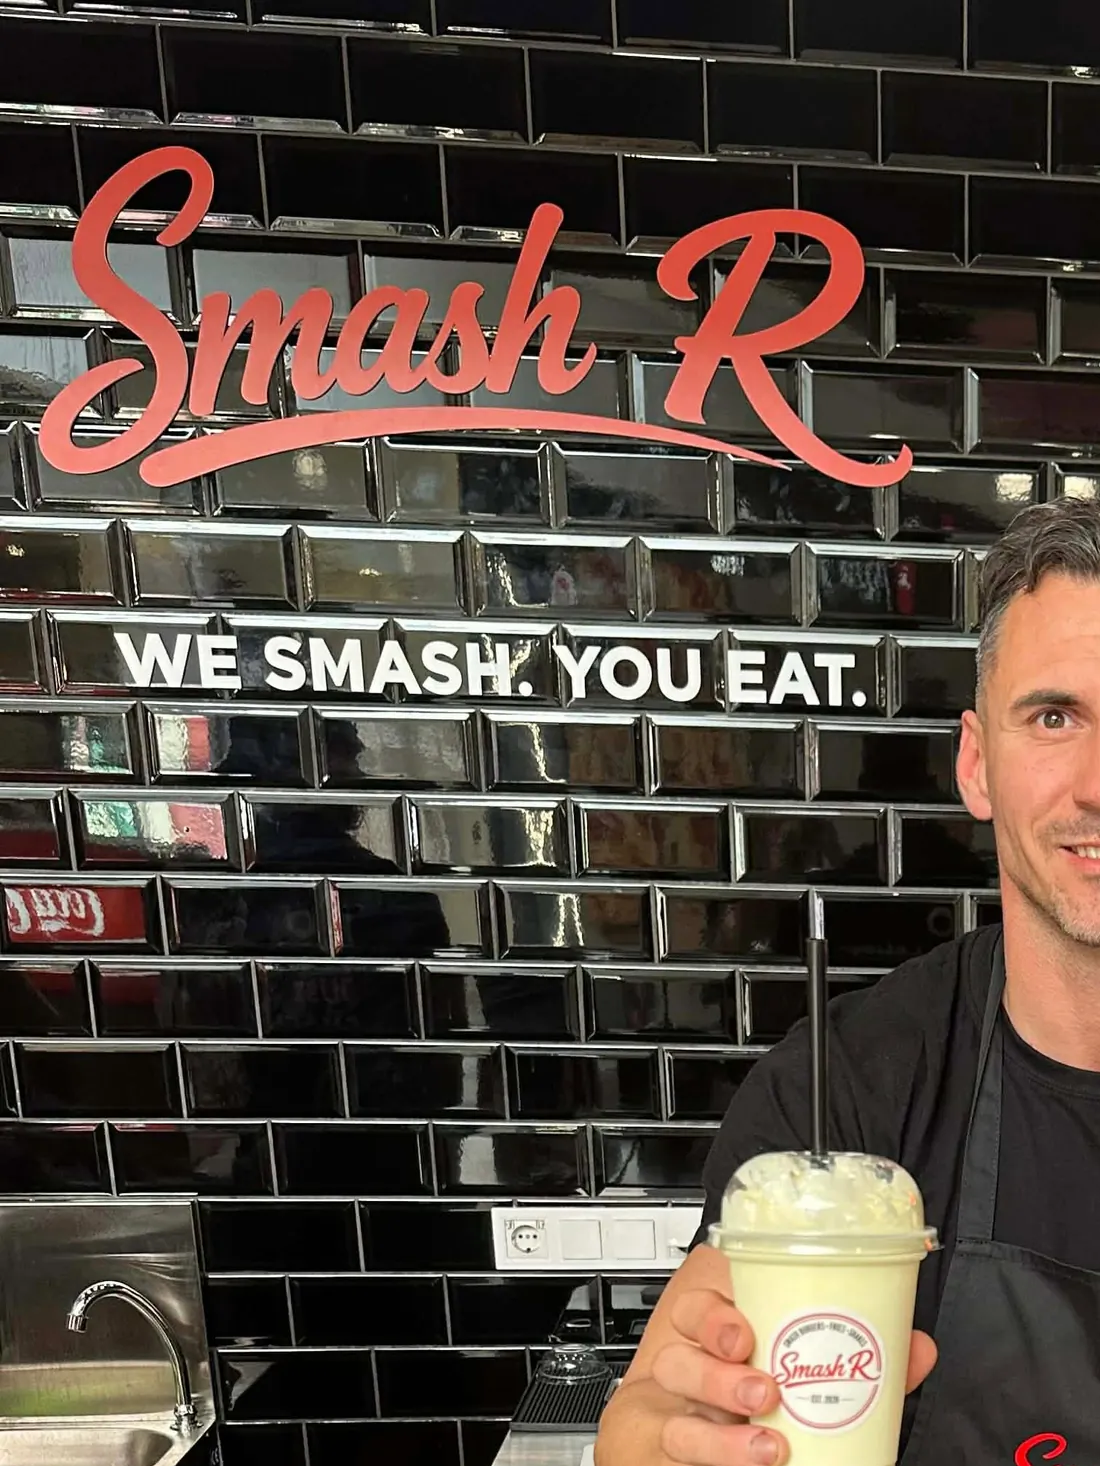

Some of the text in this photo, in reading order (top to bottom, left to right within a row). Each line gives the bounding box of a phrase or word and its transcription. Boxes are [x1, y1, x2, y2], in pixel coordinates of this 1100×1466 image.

[38, 146, 914, 488] Smash R
[114, 633, 867, 708] WE SMASH. YOU EAT.
[774, 1349, 881, 1385] Smash R
